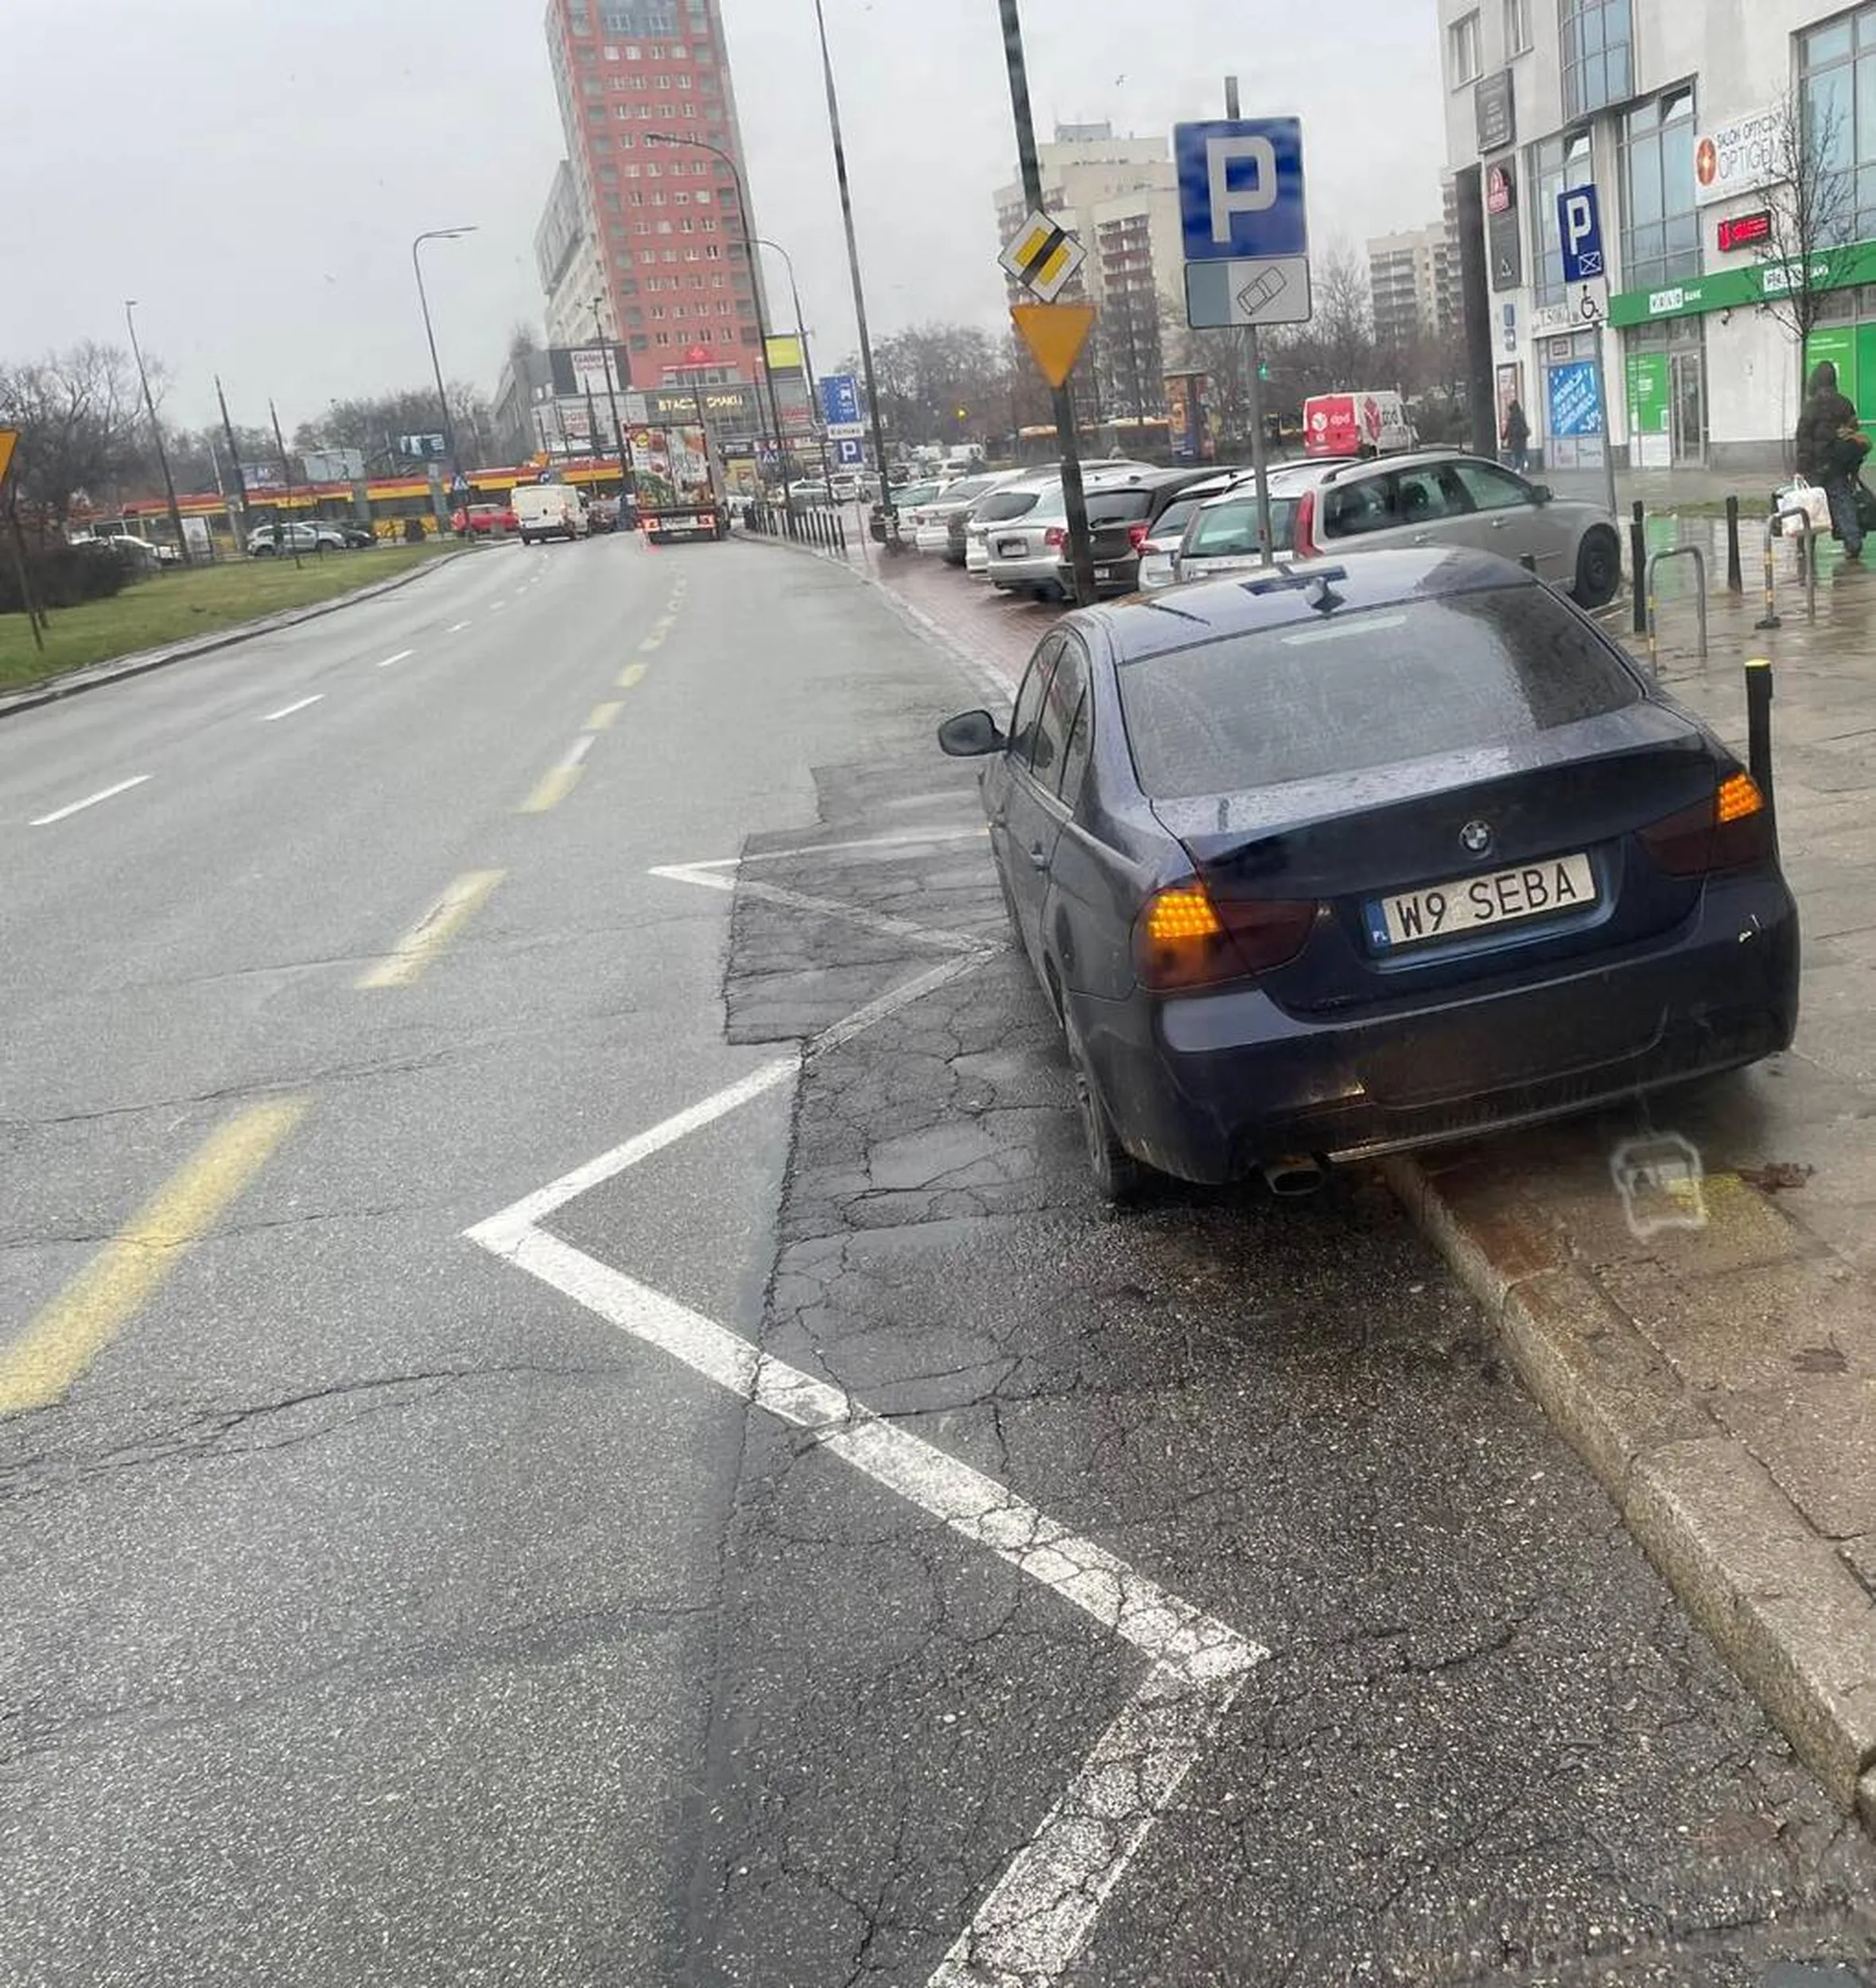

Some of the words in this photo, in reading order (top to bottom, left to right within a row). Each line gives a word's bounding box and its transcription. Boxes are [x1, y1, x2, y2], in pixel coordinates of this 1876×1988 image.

[1206, 136, 1277, 243] P
[1567, 196, 1591, 255] P
[1330, 413, 1350, 425] dpd
[841, 441, 856, 461] P
[1396, 891, 1447, 938] W9
[1470, 862, 1577, 921] SEBA
[1373, 930, 1388, 943] PL
